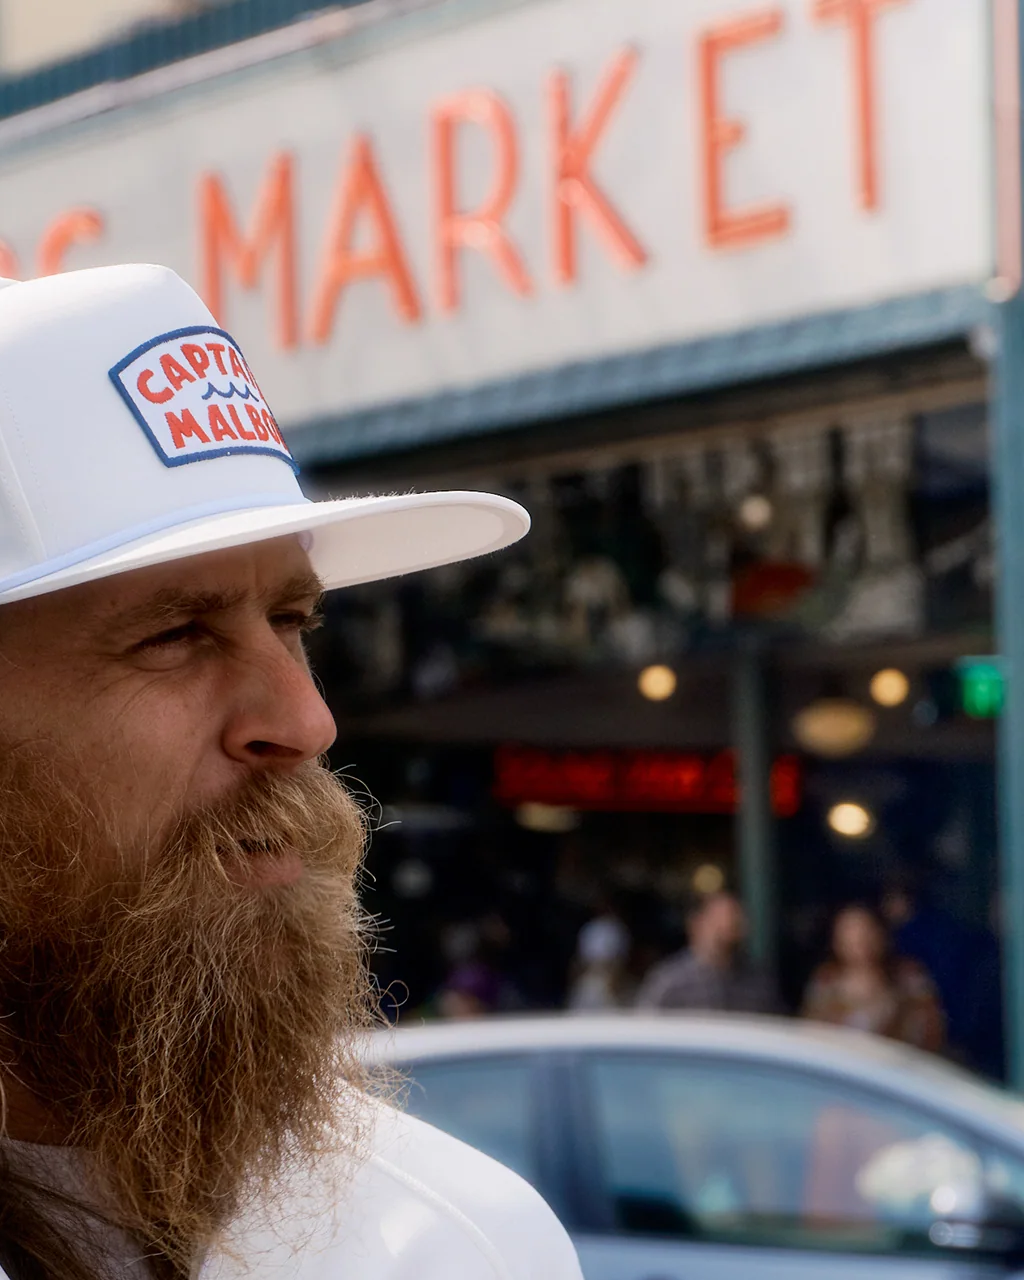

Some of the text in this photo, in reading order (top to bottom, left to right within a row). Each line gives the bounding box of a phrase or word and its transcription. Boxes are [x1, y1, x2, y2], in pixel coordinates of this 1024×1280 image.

[198, 0, 914, 350] MARKET
[136, 342, 264, 404] CAPTA
[164, 403, 288, 450] MALBO
